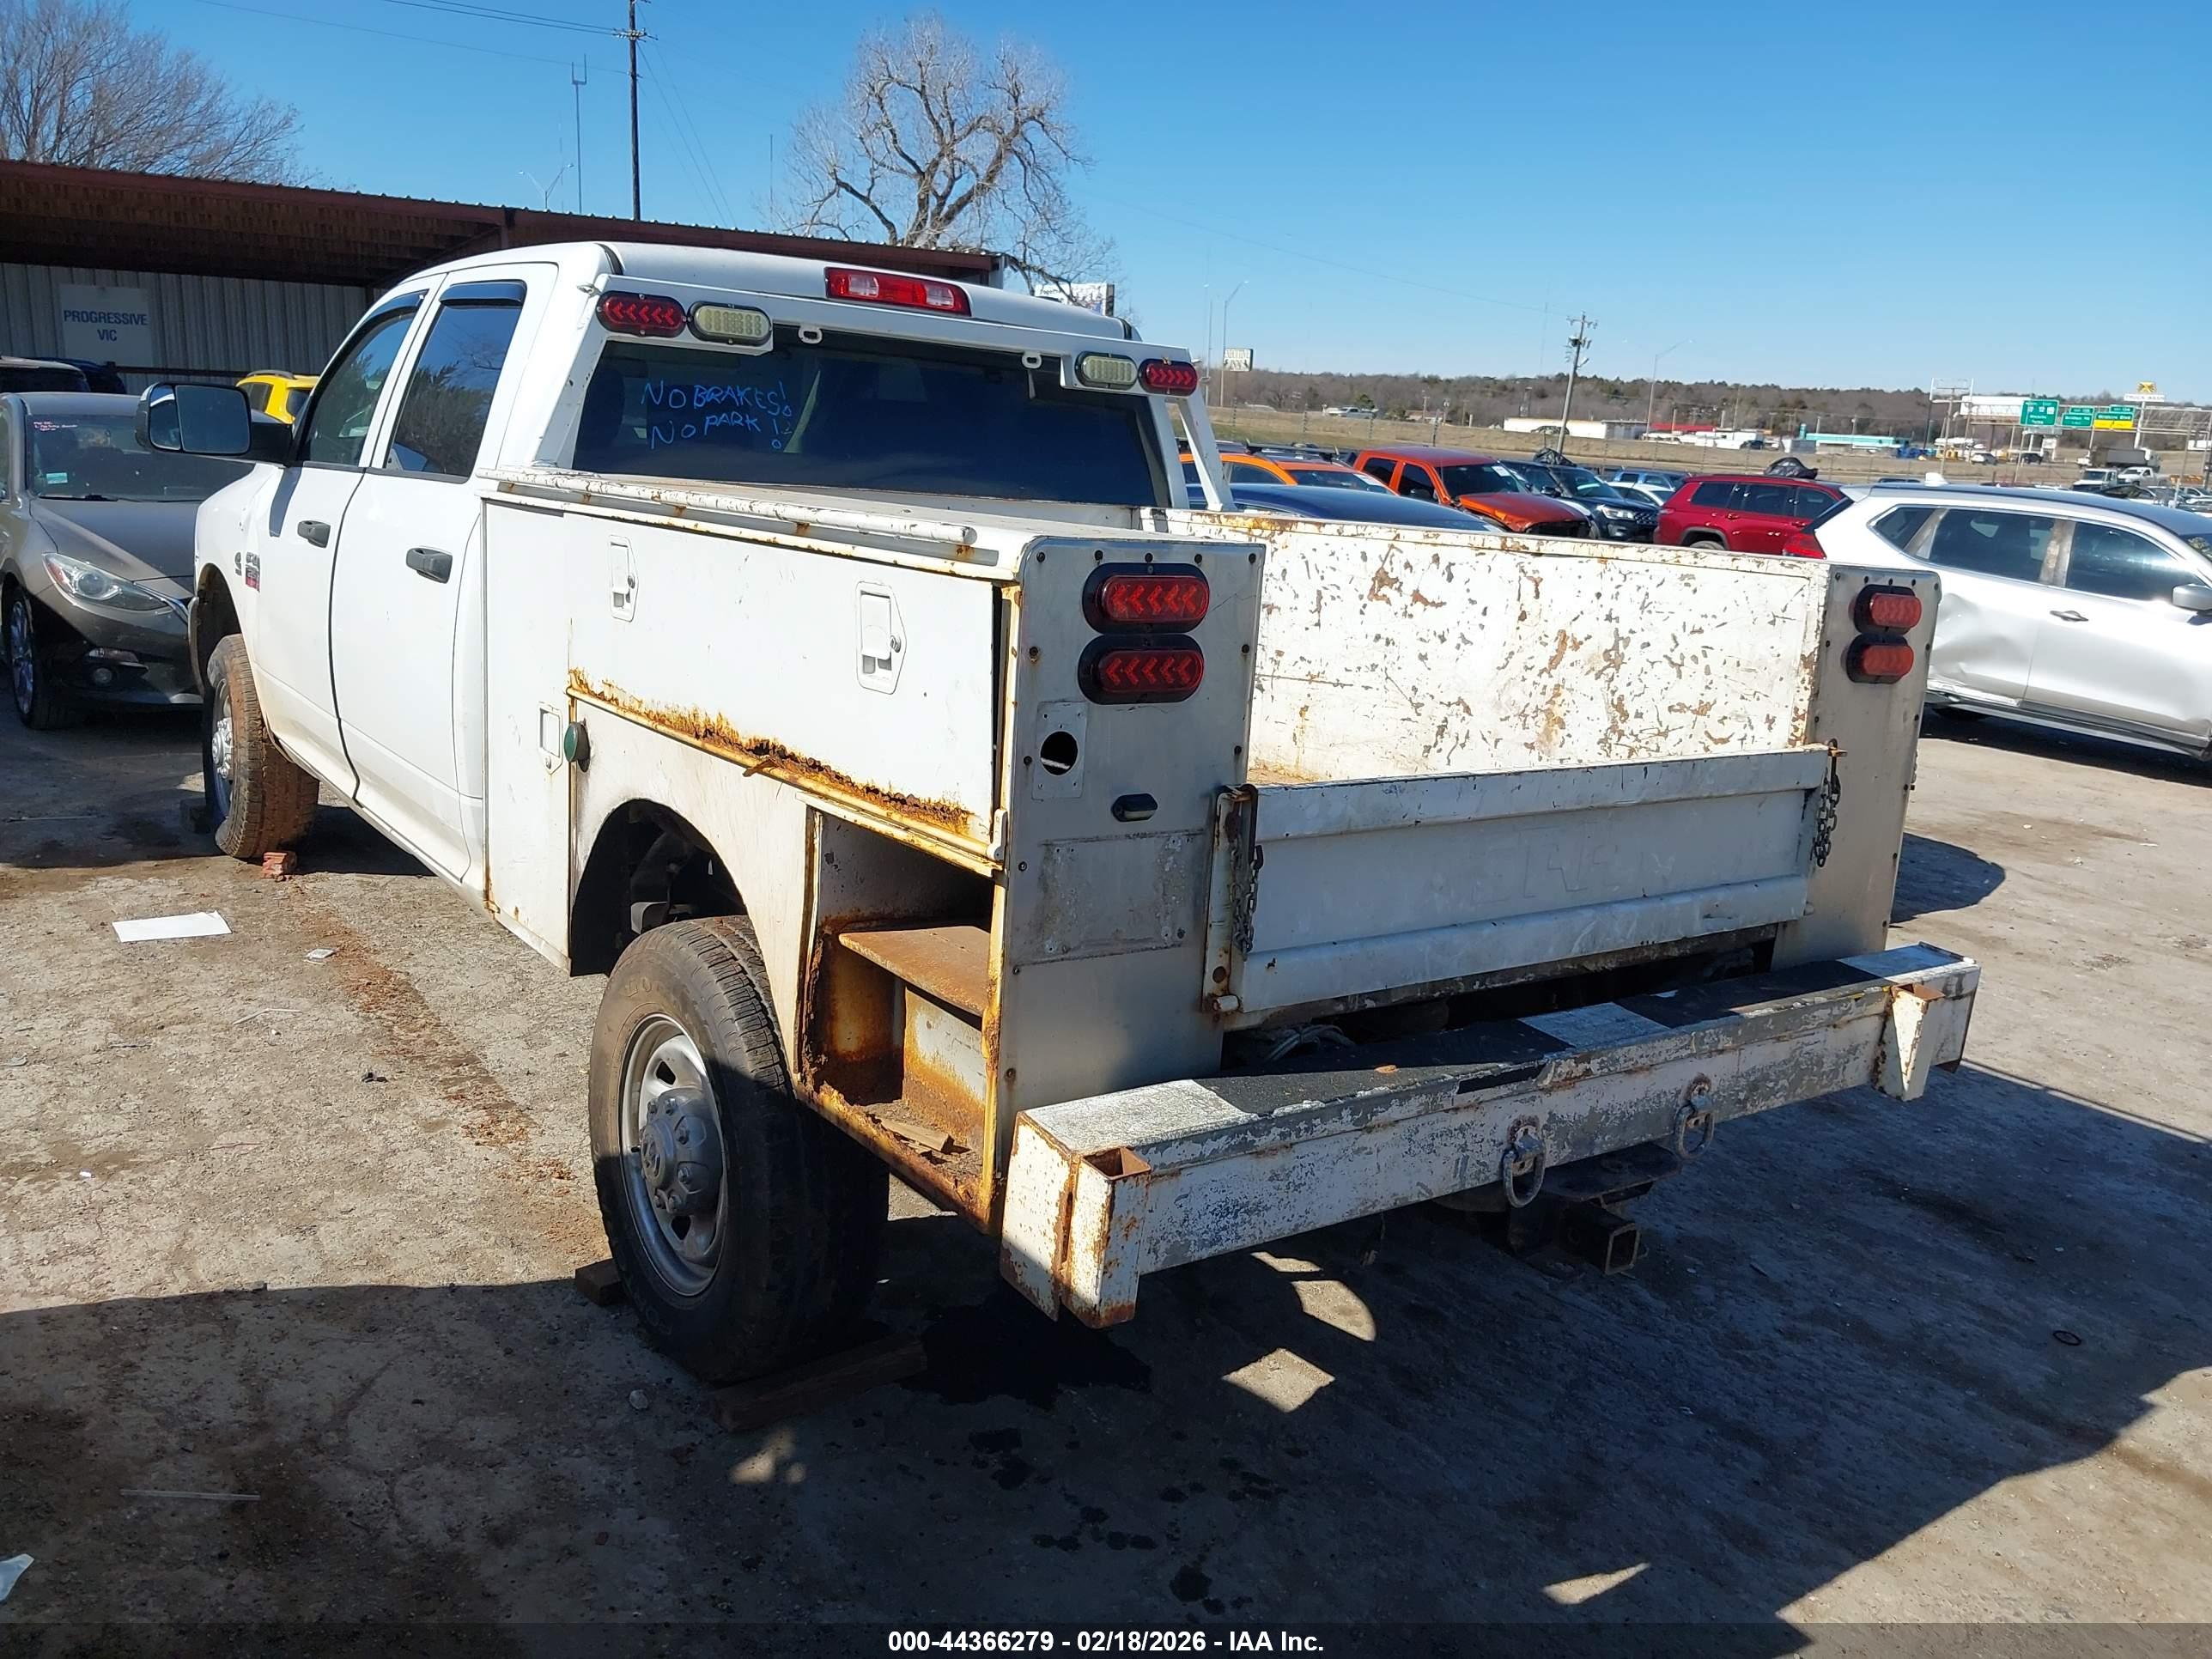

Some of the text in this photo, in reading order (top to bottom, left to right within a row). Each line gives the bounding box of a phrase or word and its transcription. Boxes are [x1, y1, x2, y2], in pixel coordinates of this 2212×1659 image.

[64, 310, 148, 325] PROGRESSIVE
[97, 329, 118, 342] VIC
[641, 380, 686, 409] NO
[651, 420, 696, 449] NO
